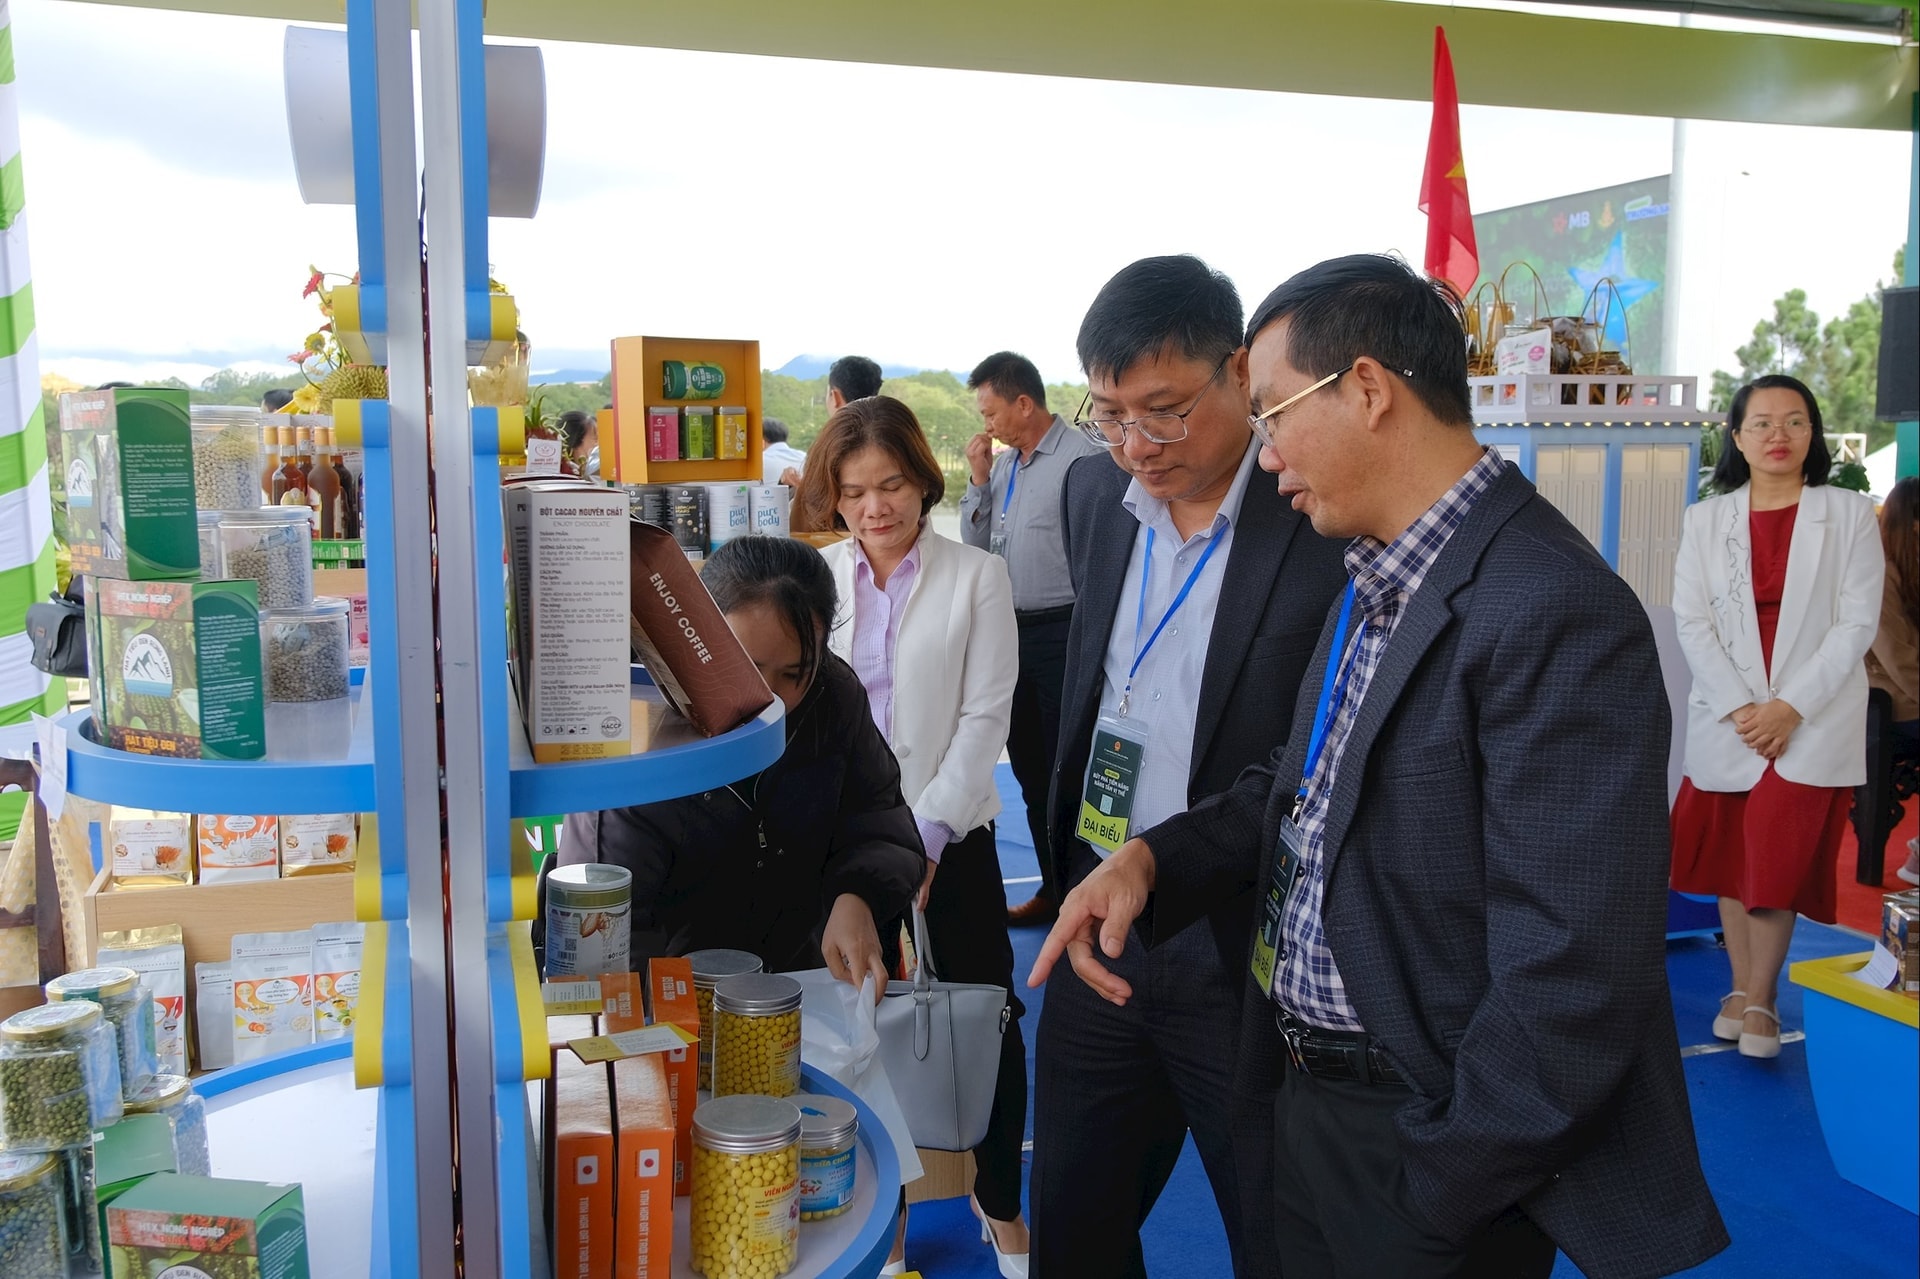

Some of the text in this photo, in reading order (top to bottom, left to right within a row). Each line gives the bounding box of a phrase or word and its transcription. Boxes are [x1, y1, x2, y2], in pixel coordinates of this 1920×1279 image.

[1569, 211, 1590, 230] MB
[539, 507, 553, 517] BỘT
[555, 509, 577, 517] CACAO
[579, 507, 604, 517] NGUYÊN
[606, 506, 623, 517] CHẤT
[757, 507, 779, 518] pure
[757, 515, 780, 528] body
[650, 572, 713, 664] ENJOY COFFEE
[1084, 818, 1120, 842] ĐẠI BIỂU
[764, 1186, 781, 1197] VIÊN
[639, 1206, 649, 1221] HOA
[139, 1222, 225, 1238] HTX NÔNG NGHIỆP
